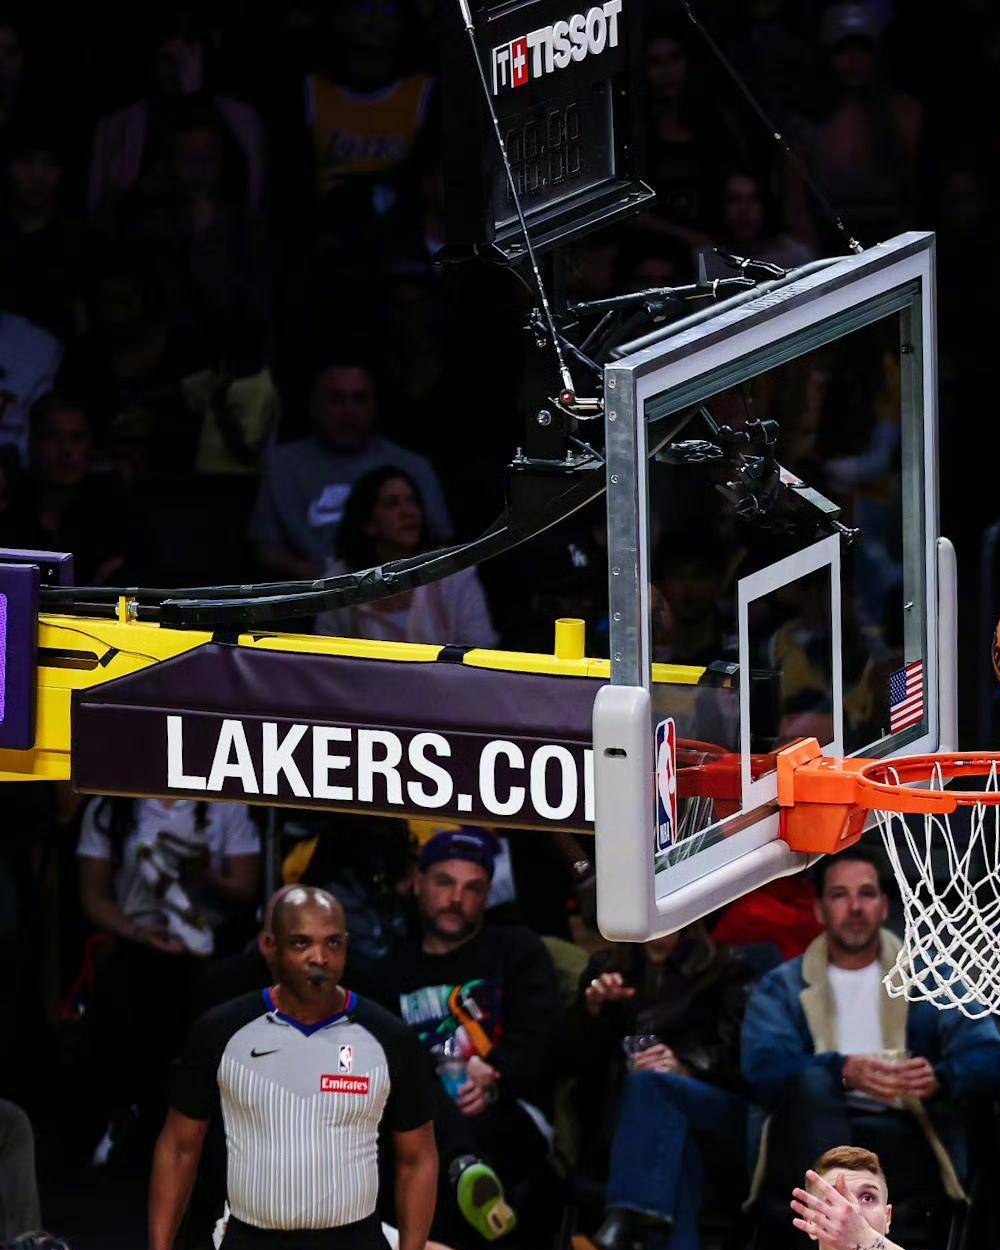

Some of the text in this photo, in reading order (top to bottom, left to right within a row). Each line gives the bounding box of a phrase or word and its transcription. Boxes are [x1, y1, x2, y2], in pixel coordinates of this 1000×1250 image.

[526, 0, 623, 79] TISSOT
[166, 715, 596, 822] LAKERS.CO
[321, 1077, 368, 1091] Emirates
